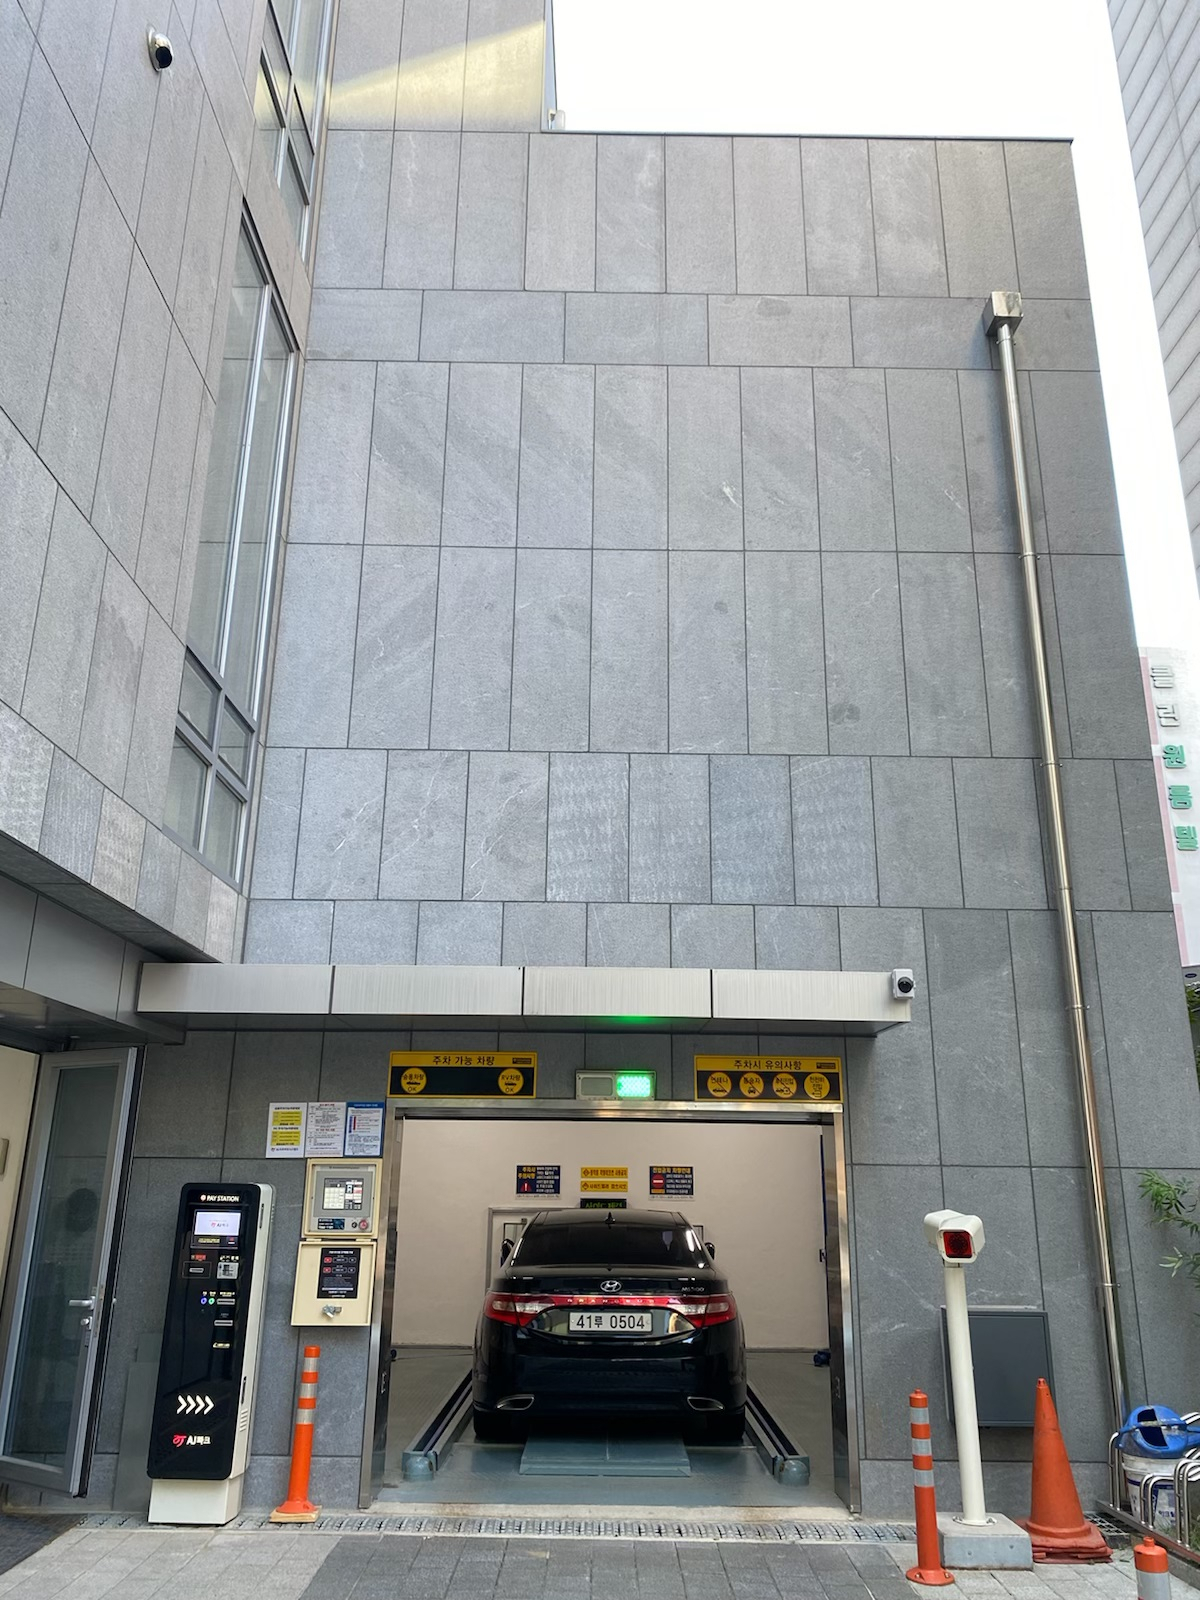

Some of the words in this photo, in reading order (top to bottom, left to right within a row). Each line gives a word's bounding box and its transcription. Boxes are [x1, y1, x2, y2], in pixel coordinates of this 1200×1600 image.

[432, 1056, 451, 1066] 주차
[455, 1056, 473, 1066] 가능
[477, 1056, 495, 1067] 차량
[734, 1060, 761, 1069] 주차시
[765, 1060, 802, 1070] 유의사항
[576, 1314, 603, 1329] 41루
[610, 1314, 645, 1329] 0504
[186, 1435, 211, 1446] AJ파크
